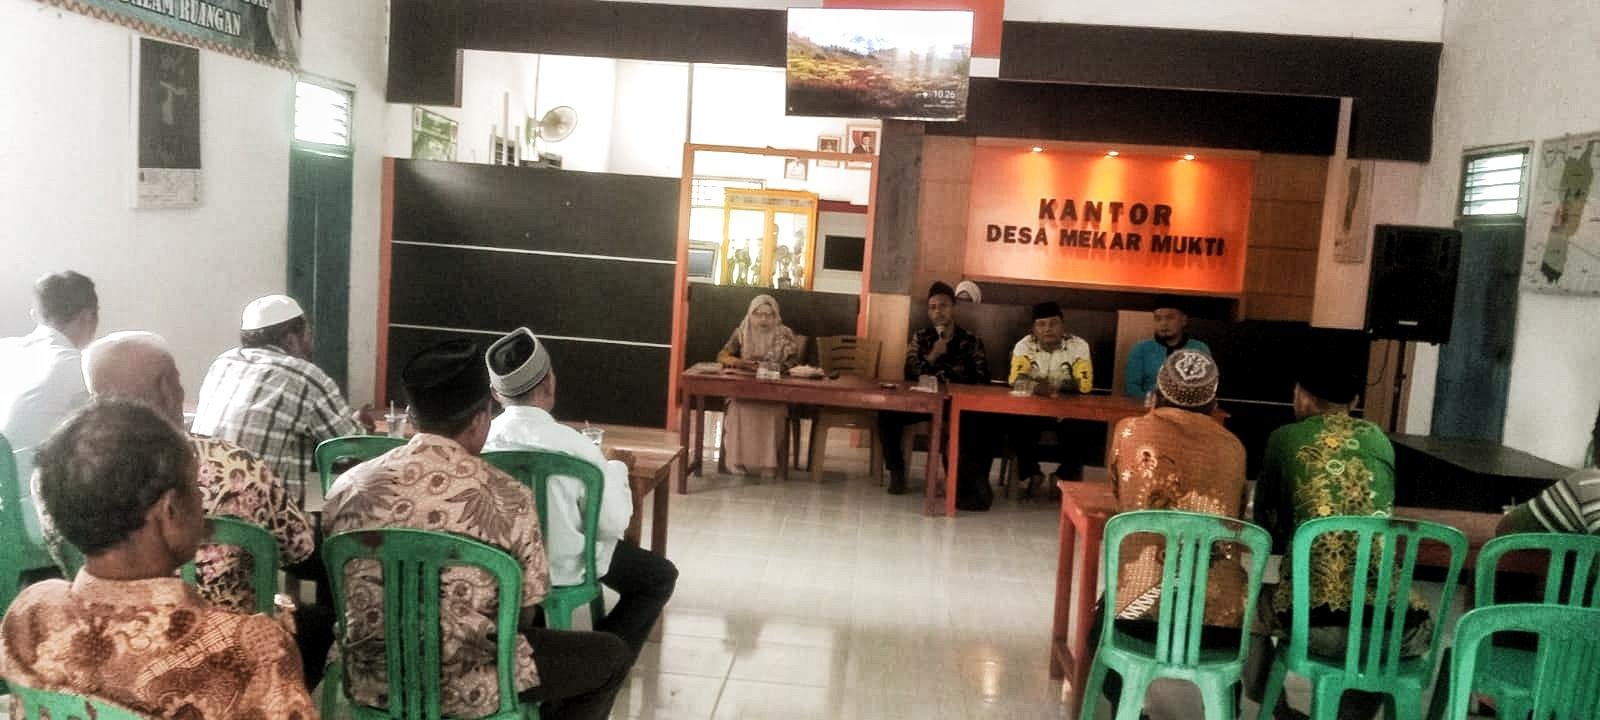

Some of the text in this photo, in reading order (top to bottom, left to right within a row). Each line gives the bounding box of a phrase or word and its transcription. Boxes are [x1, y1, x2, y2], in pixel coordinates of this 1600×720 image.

[179, 0, 240, 36] RUANGAN
[1038, 198, 1172, 226] KANTOR
[986, 224, 1225, 257] DESA MEKAR MUKTI
